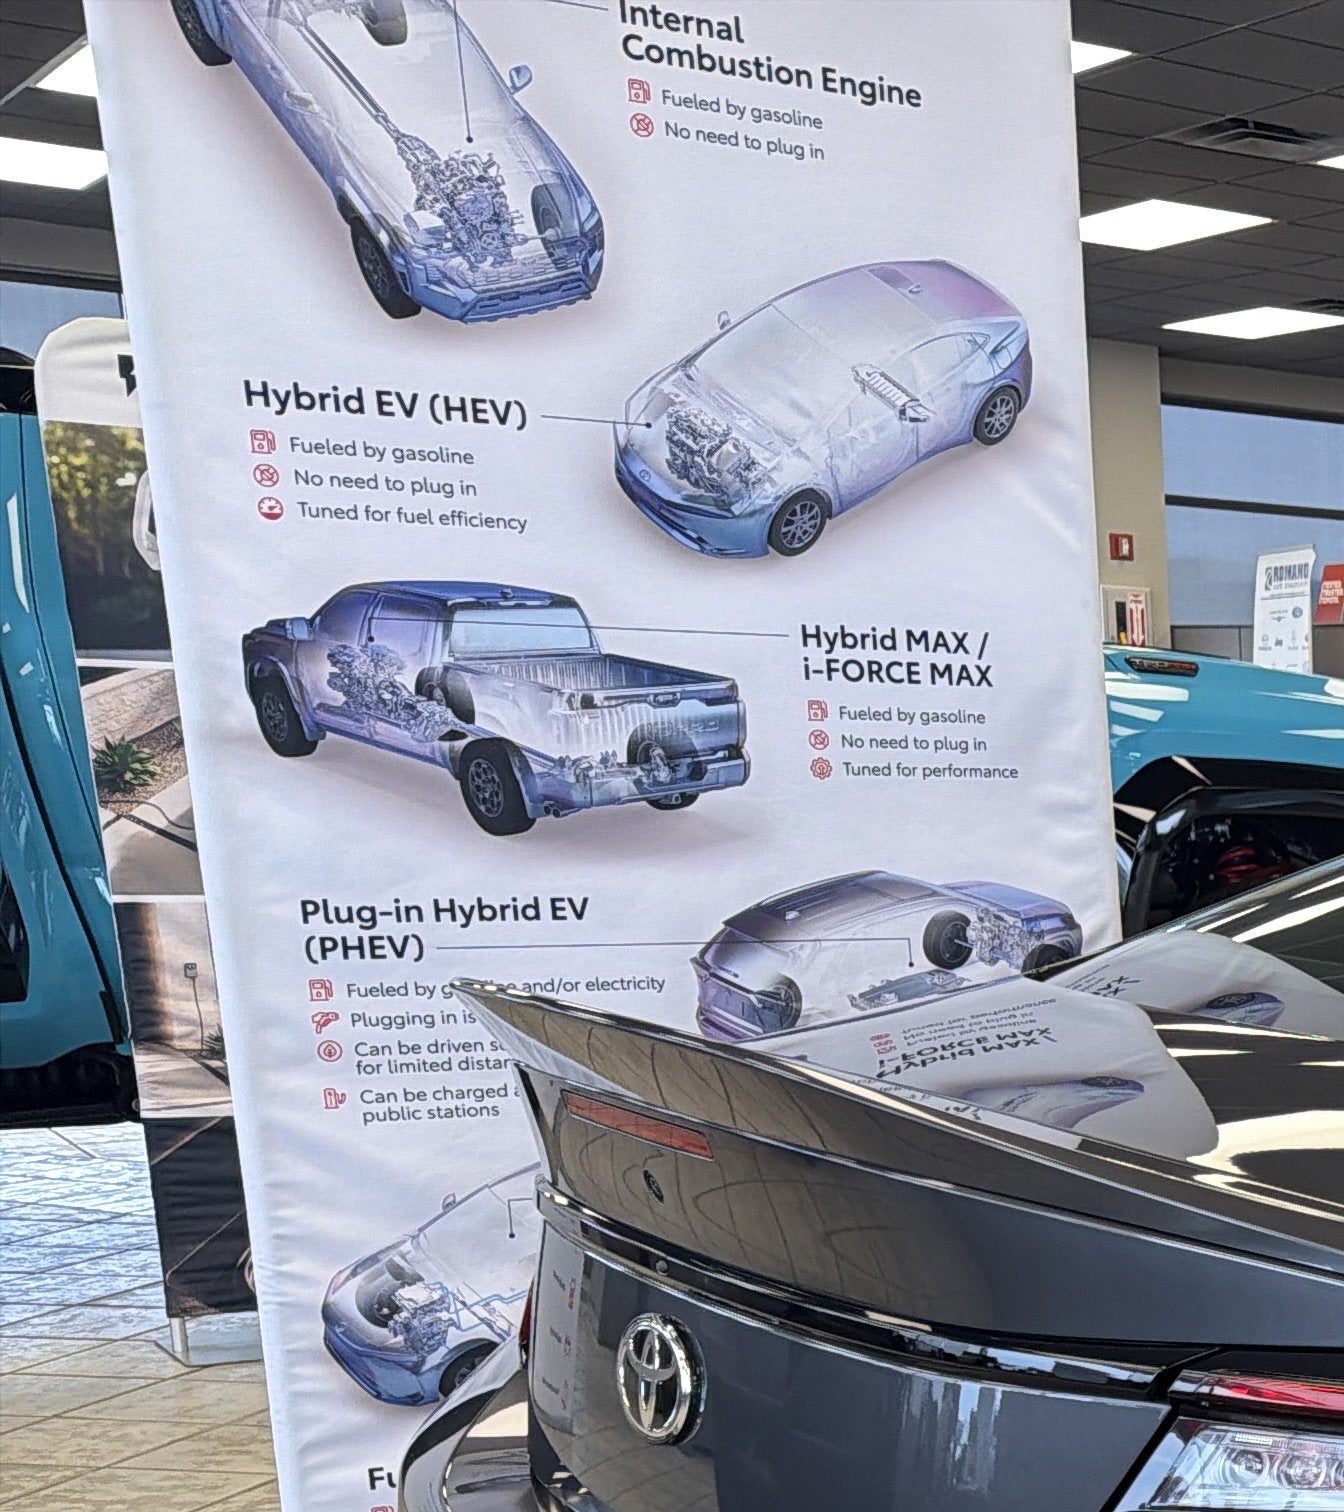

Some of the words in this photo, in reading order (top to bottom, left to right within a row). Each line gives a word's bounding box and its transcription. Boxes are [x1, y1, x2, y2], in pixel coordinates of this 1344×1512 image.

[619, 0, 745, 43] Internal
[621, 33, 813, 89] Combustion
[821, 67, 922, 108] Engine
[662, 89, 720, 113] Fueled
[726, 99, 747, 120] by
[751, 106, 823, 130] gasoline
[665, 121, 691, 139] No
[696, 127, 739, 148] need
[745, 135, 761, 150] to
[767, 138, 805, 160] plug
[809, 143, 825, 160] in
[244, 380, 365, 416] Hybrid
[376, 390, 418, 418] EV
[429, 393, 527, 430] (HEV)
[290, 437, 356, 456] Fueled
[364, 441, 386, 462] by
[392, 446, 475, 464] gasoline
[294, 470, 324, 487] No
[330, 474, 378, 490] need
[384, 476, 404, 492] to
[411, 476, 454, 498] plug
[460, 480, 478, 496] in
[297, 502, 358, 520] Tuned
[364, 505, 391, 522] for
[396, 507, 434, 525] fuel
[439, 510, 528, 534] efficiency
[1273, 563, 1309, 582] ROMANO
[801, 624, 897, 654] Hybrid
[906, 629, 970, 654] MAX
[977, 632, 989, 660] /
[803, 657, 921, 684] i-FORCE
[930, 663, 993, 687] MAX
[839, 706, 892, 721] Fueled
[897, 708, 915, 725] by
[920, 709, 986, 725] gasoline
[841, 734, 864, 748] No
[869, 735, 908, 750] need
[913, 737, 930, 750] to
[934, 736, 969, 754] plug
[973, 737, 987, 751] in
[843, 762, 892, 777] Tuned
[896, 763, 918, 777] for
[922, 763, 1018, 780] performance
[301, 898, 424, 931] Plug-in
[433, 897, 541, 928] Hybrid
[550, 898, 589, 920] EV
[305, 934, 424, 964] (PHEV)
[347, 982, 409, 998] Fueled
[415, 982, 436, 1001] by
[522, 979, 580, 995] and/or
[585, 976, 665, 994] electricity
[351, 1012, 436, 1030] Plugging
[440, 1011, 457, 1026] in
[462, 1011, 477, 1025] is
[354, 1042, 392, 1058] Can
[399, 1040, 422, 1055] be
[426, 1040, 484, 1054] driven
[356, 1060, 383, 1076] for
[388, 1058, 452, 1074] limited
[360, 1089, 399, 1104] Can
[404, 1088, 428, 1102] be
[432, 1083, 509, 1104] charged
[363, 1105, 422, 1126] public
[427, 1103, 500, 1120] stations
[368, 1467, 396, 1490] Fu
